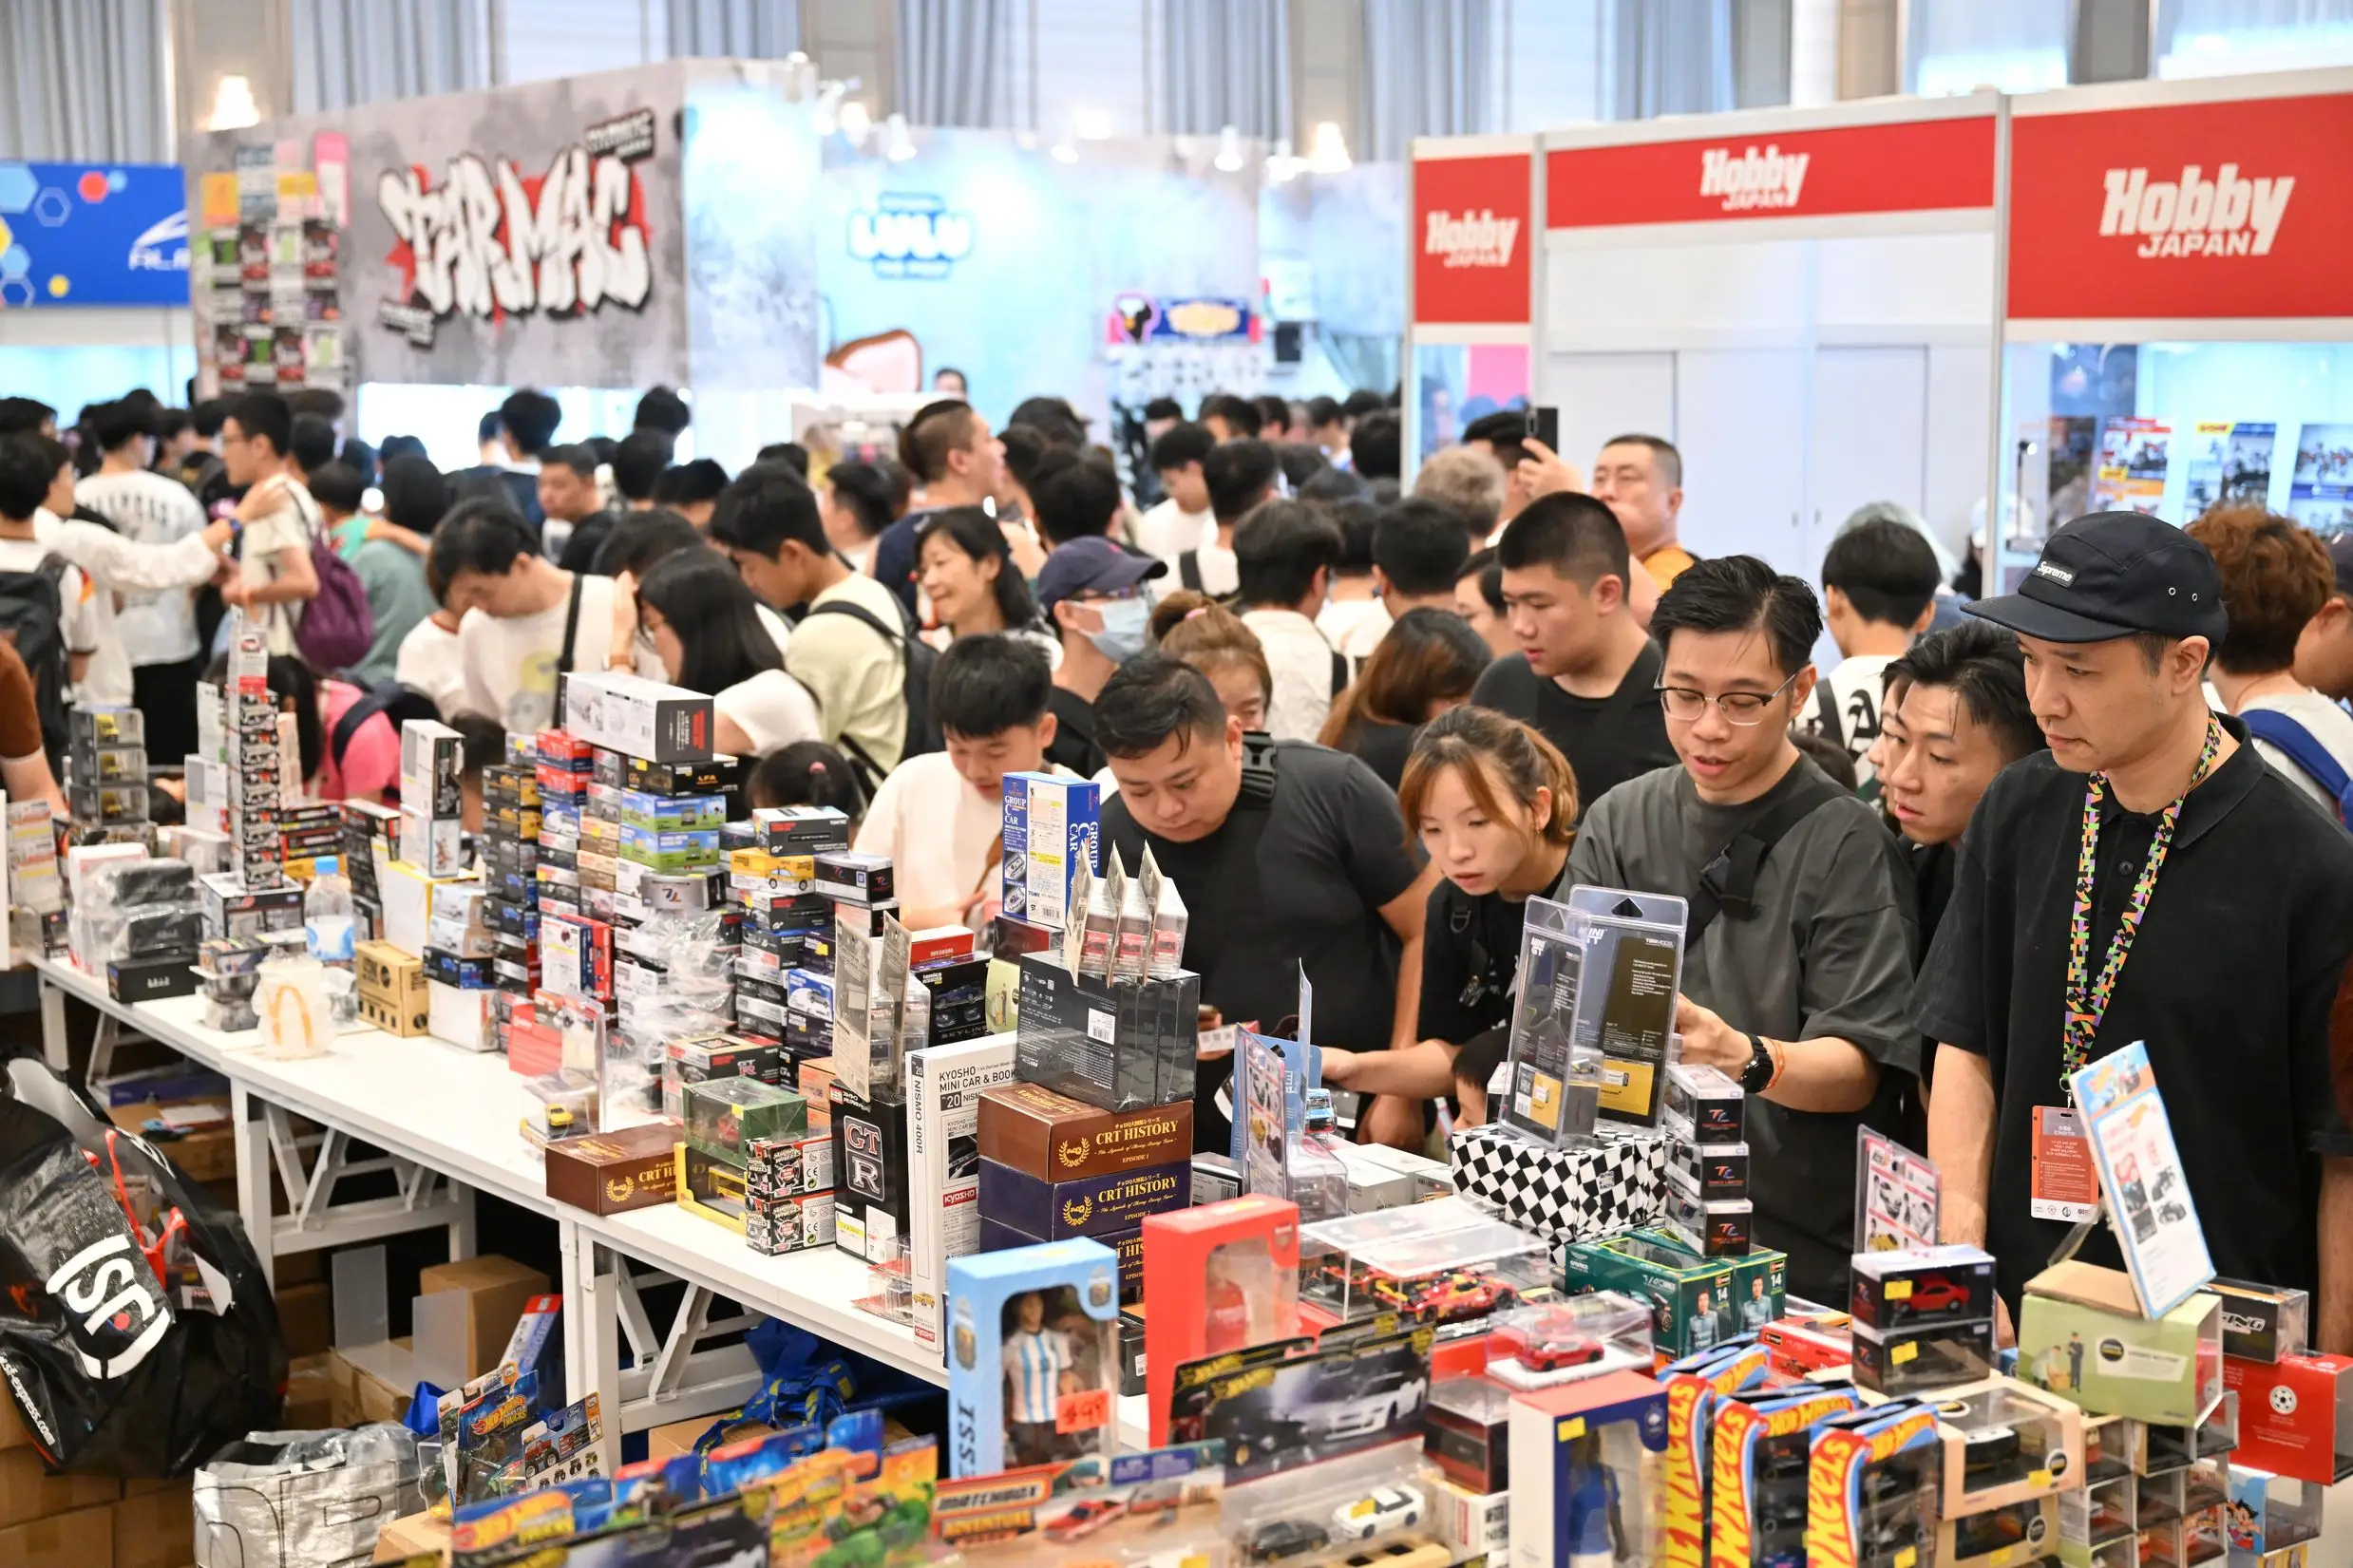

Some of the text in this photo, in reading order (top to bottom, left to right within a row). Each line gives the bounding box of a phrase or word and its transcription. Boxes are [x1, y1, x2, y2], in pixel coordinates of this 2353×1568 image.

[1699, 143, 1811, 208] Hobby
[1721, 191, 1788, 212] JAPAN
[2098, 161, 2297, 255] Hobby
[1425, 208, 1520, 267] Hobby
[2137, 231, 2251, 258] JAPAN
[2037, 560, 2073, 582] Supreme
[1004, 795, 1027, 806] GROUP
[1004, 815, 1018, 825] CAR
[1069, 822, 1078, 852] CAR
[1090, 822, 1098, 869] GROUP
[1530, 936, 1547, 949] MINI
[916, 1065, 923, 1076] 20
[939, 1066, 976, 1082] KYOSHO
[939, 1081, 960, 1093] MINI
[962, 1075, 980, 1090] CAR
[983, 1074, 990, 1083] &
[914, 1080, 922, 1121] NISMO
[946, 1094, 960, 1108] 20
[968, 1121, 978, 1129] BOO
[1095, 1120, 1179, 1145] CRT HISTORY
[845, 1122, 880, 1156] GT
[1122, 1155, 1145, 1163] EPISODE
[638, 1168, 662, 1182] CRT
[851, 1156, 881, 1195] R
[944, 1188, 977, 1204] KYOSHO
[1098, 1176, 1179, 1203] CRT HISTORY
[1124, 1211, 1146, 1220] EPISODE
[1771, 1274, 1782, 1287] 14
[1717, 1287, 1728, 1300] 14
[915, 1328, 935, 1342] KYOSHO
[503, 1410, 527, 1429] TRUCKS
[938, 1483, 1036, 1512] MATCHBOX
